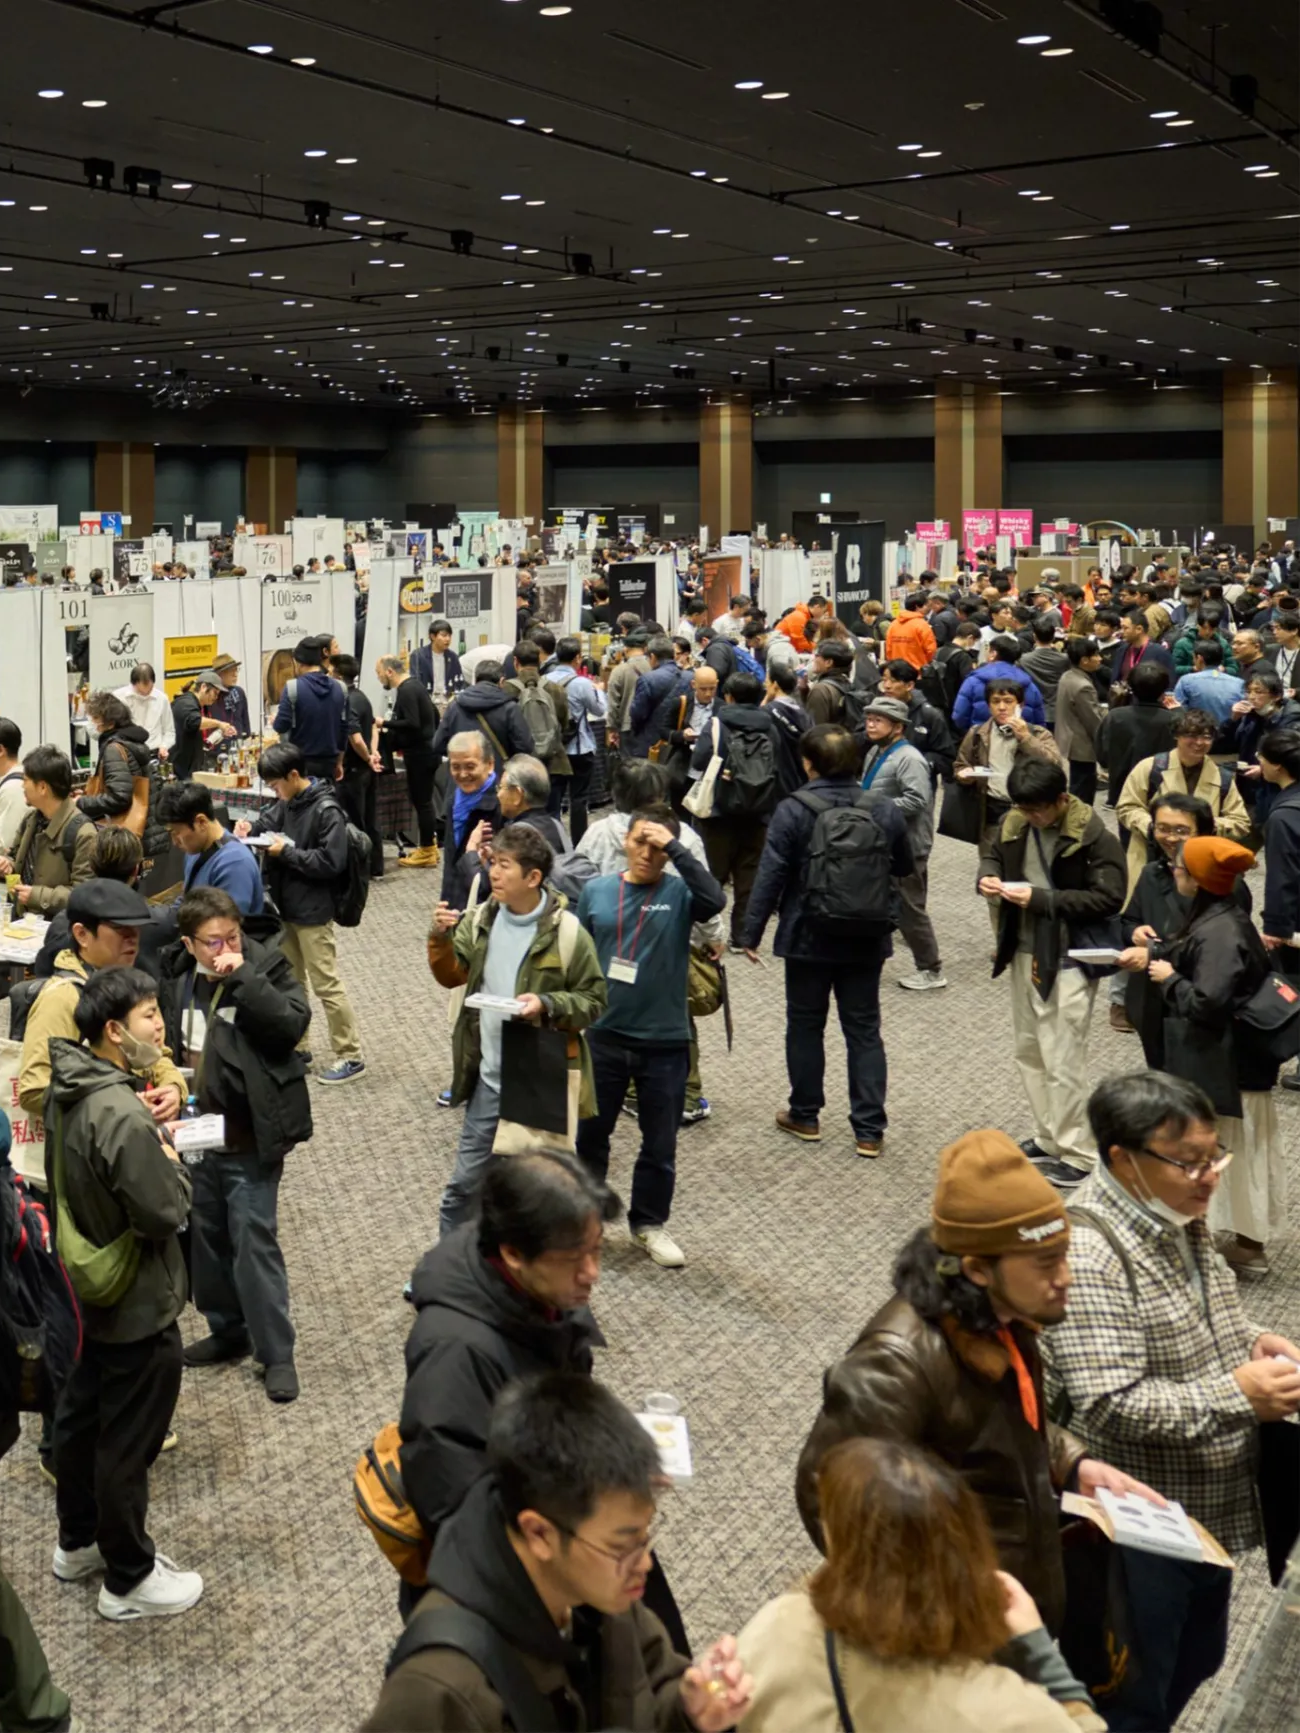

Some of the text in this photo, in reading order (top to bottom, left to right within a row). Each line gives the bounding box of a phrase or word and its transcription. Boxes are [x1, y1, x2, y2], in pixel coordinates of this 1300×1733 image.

[133, 558, 149, 572] 75
[261, 551, 276, 565] 76
[271, 590, 291, 607] 100
[59, 599, 88, 619] 101
[108, 658, 140, 671] ACORN
